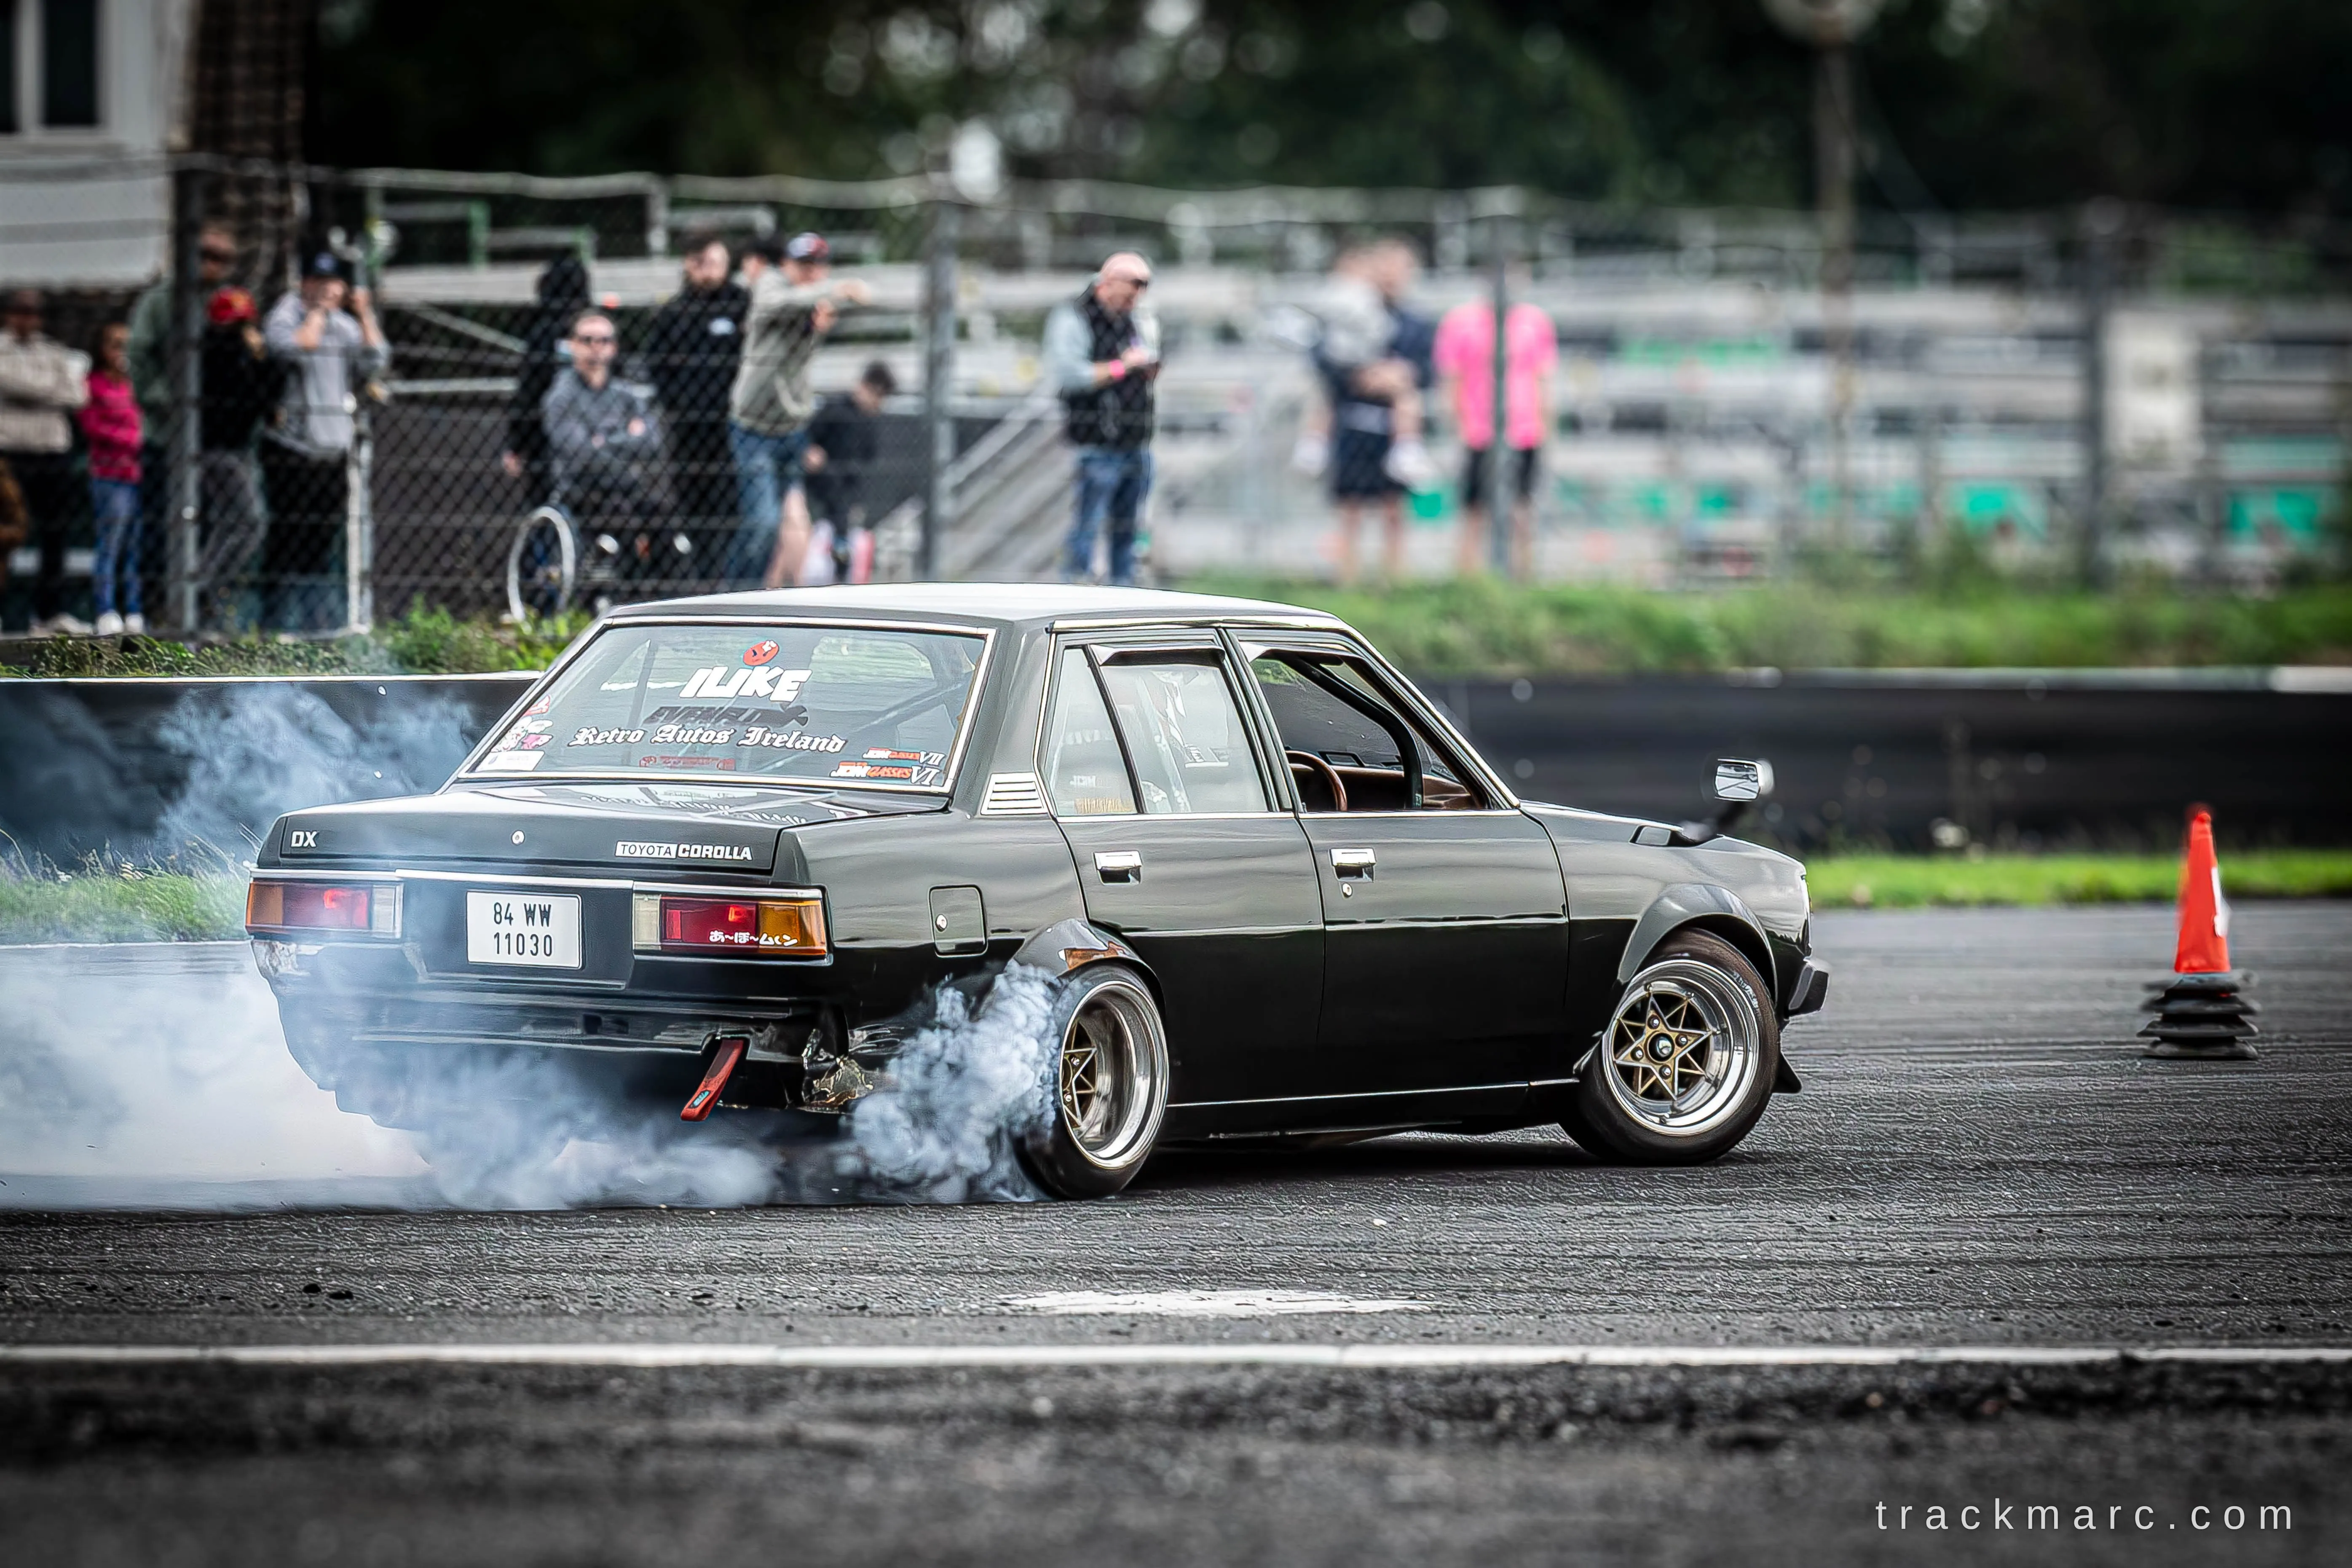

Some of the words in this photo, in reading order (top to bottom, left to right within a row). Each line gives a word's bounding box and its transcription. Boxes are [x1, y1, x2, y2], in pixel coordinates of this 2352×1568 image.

[568, 726, 646, 747] Retro
[651, 724, 736, 745] Autos
[737, 726, 847, 753] Ireland
[291, 831, 317, 847] DX
[621, 844, 672, 856] TOYOTA
[678, 843, 753, 860] COROLLA
[494, 902, 514, 926] 84
[524, 903, 552, 927] WW
[493, 932, 552, 957] 11030
